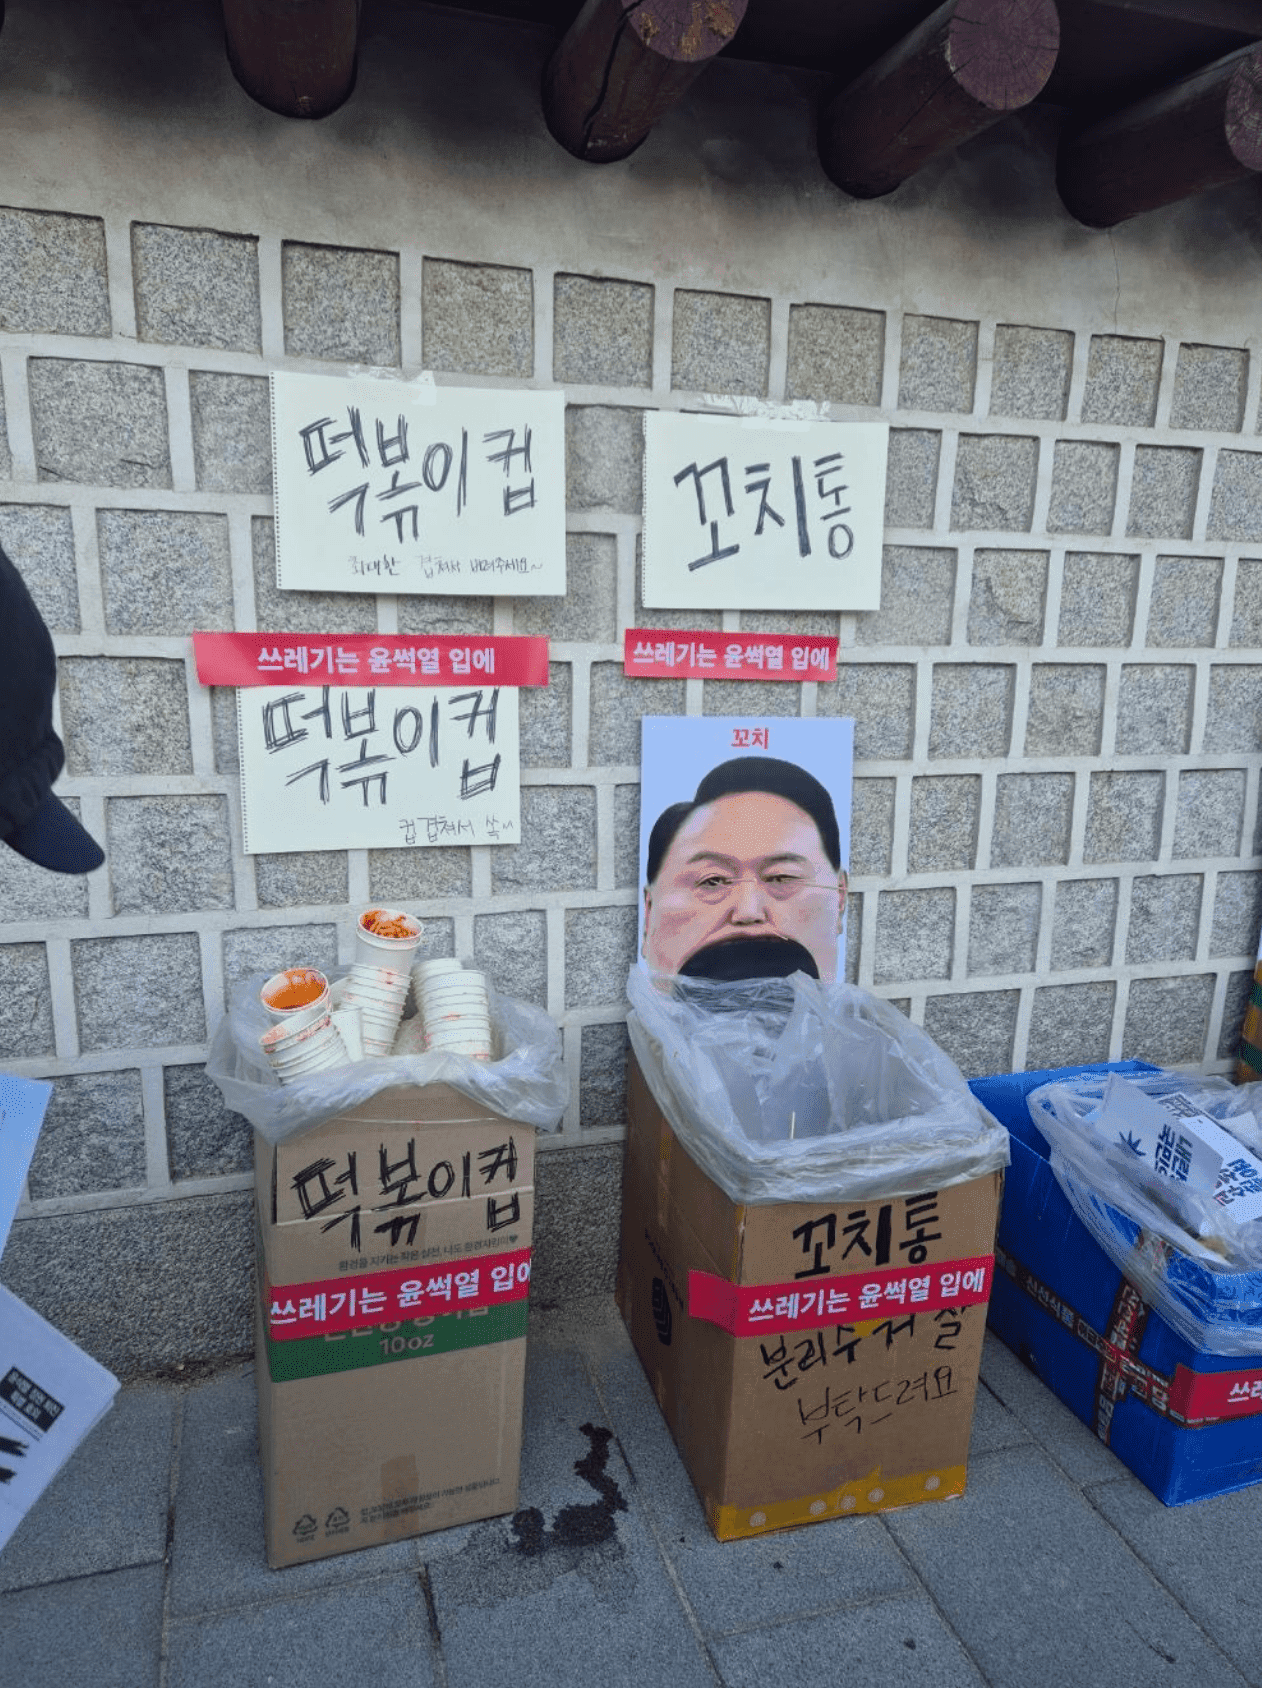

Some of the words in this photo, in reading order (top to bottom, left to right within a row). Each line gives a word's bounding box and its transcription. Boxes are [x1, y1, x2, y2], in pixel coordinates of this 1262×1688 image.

[673, 452, 854, 572] 꼬치통
[257, 646, 360, 674] 쓰레기는
[449, 647, 495, 675] 입에
[633, 641, 717, 668] 쓰레기는
[792, 646, 830, 671] 입에
[731, 727, 770, 750] 꼬치
[792, 1190, 942, 1280] 꼬치통
[270, 1288, 388, 1325] 쓰레기는
[748, 1289, 851, 1322] 쓰레기는
[940, 1267, 986, 1298] 입에
[379, 1324, 434, 1355] 10oz
[797, 1366, 958, 1444] 부탁드려요
